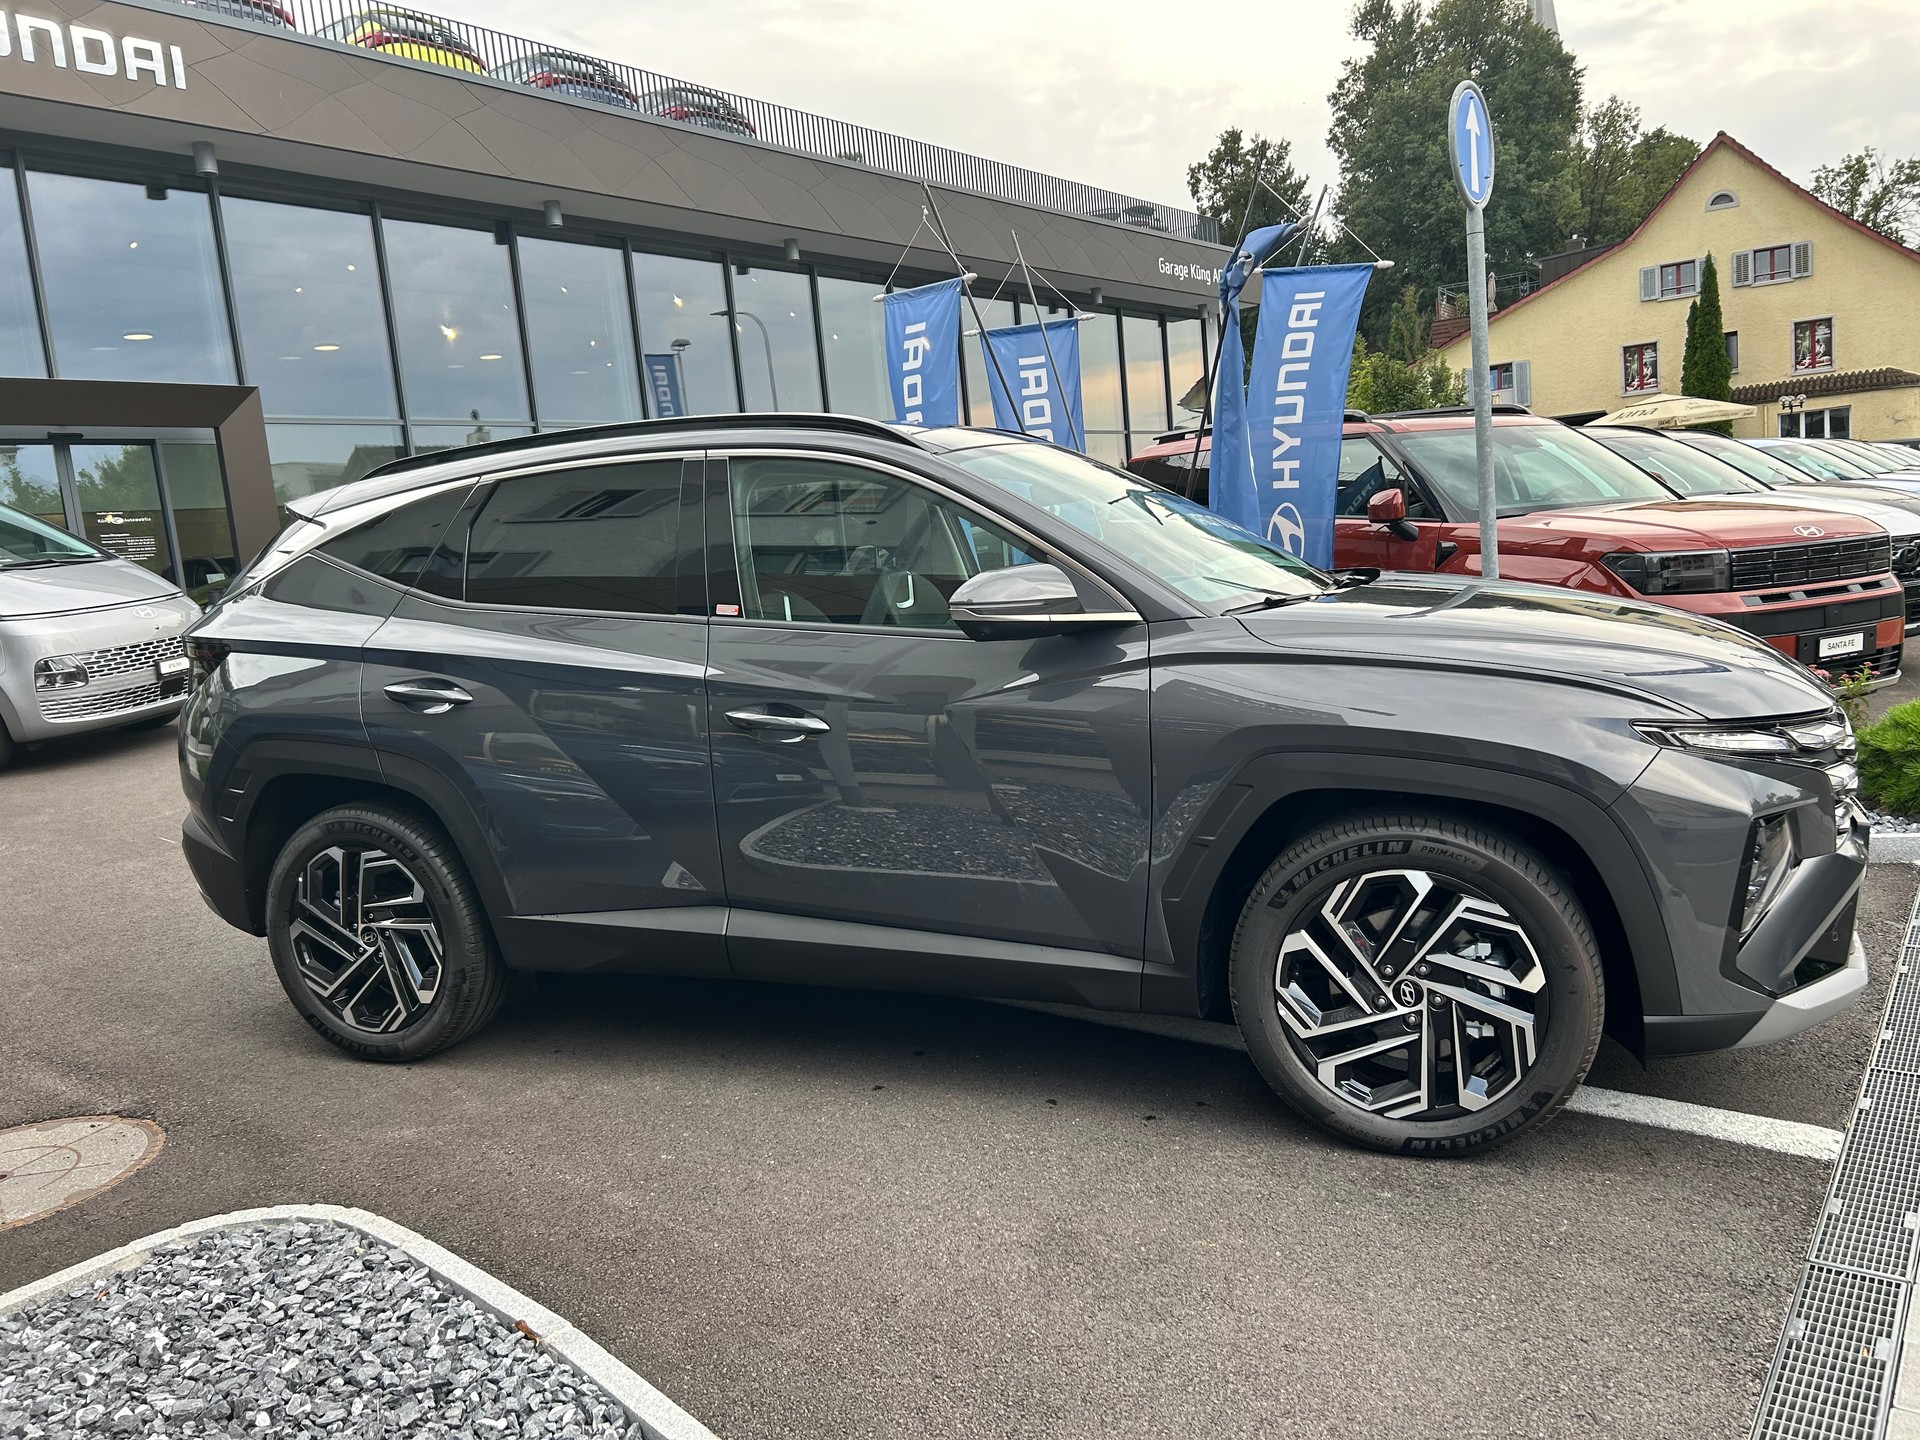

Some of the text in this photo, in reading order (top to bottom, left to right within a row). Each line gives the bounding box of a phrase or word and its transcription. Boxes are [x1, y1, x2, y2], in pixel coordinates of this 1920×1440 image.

[0, 10, 187, 90] NDAI
[1158, 257, 1189, 281] Garage
[1190, 263, 1212, 286] Küng
[1272, 291, 1326, 490] HYUNDAI
[1827, 639, 1855, 650] SANTA FE
[344, 822, 415, 859] MICHELIN
[1292, 840, 1405, 889] MICHELIN
[1420, 845, 1471, 863] PRIMACY
[1410, 1110, 1526, 1151] MICHELIN
